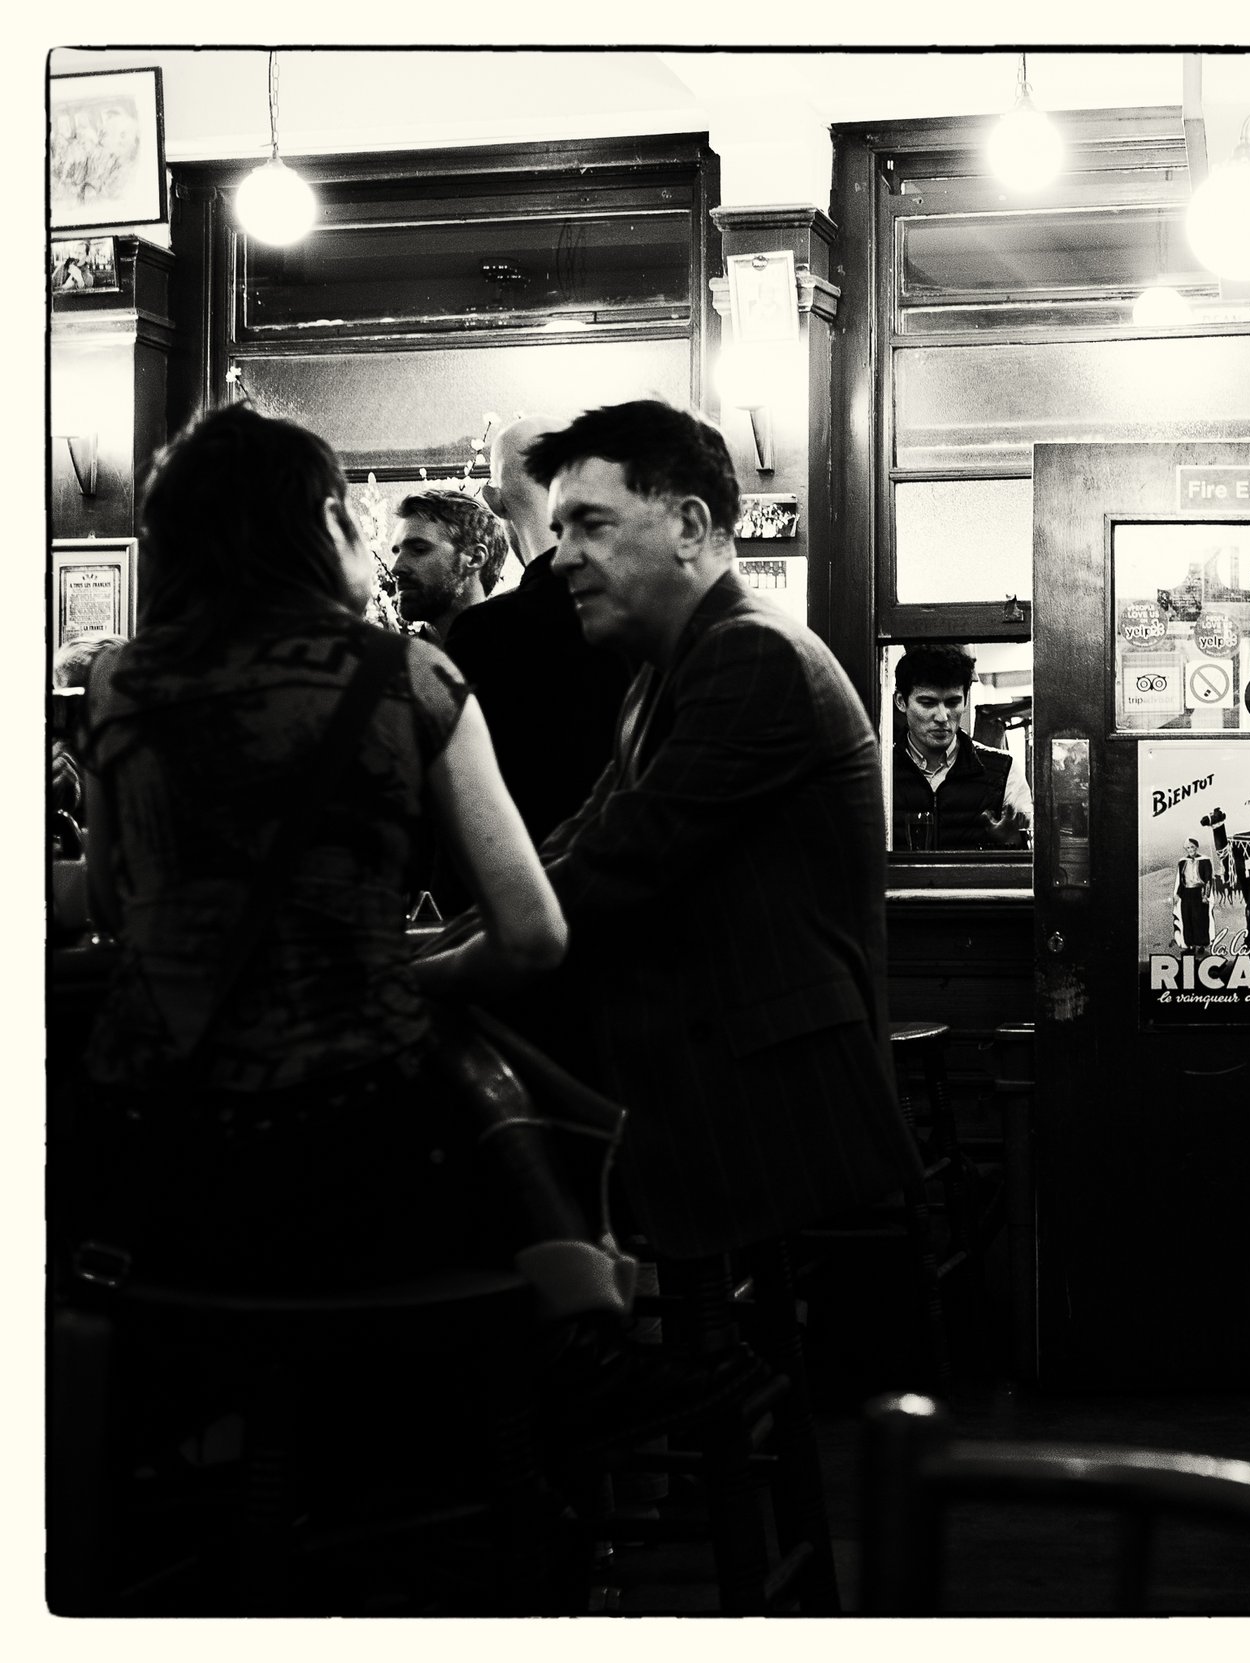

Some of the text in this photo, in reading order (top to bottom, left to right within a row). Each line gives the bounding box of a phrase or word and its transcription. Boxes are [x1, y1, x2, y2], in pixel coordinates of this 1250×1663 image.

[1188, 481, 1228, 499] Fire
[1127, 610, 1160, 619] LOVE US
[1125, 624, 1152, 640] yelp
[1201, 621, 1221, 629] LOVE
[1199, 634, 1226, 650] yelp
[1157, 990, 1172, 1003] le
[1175, 992, 1240, 1009] vainqueur
